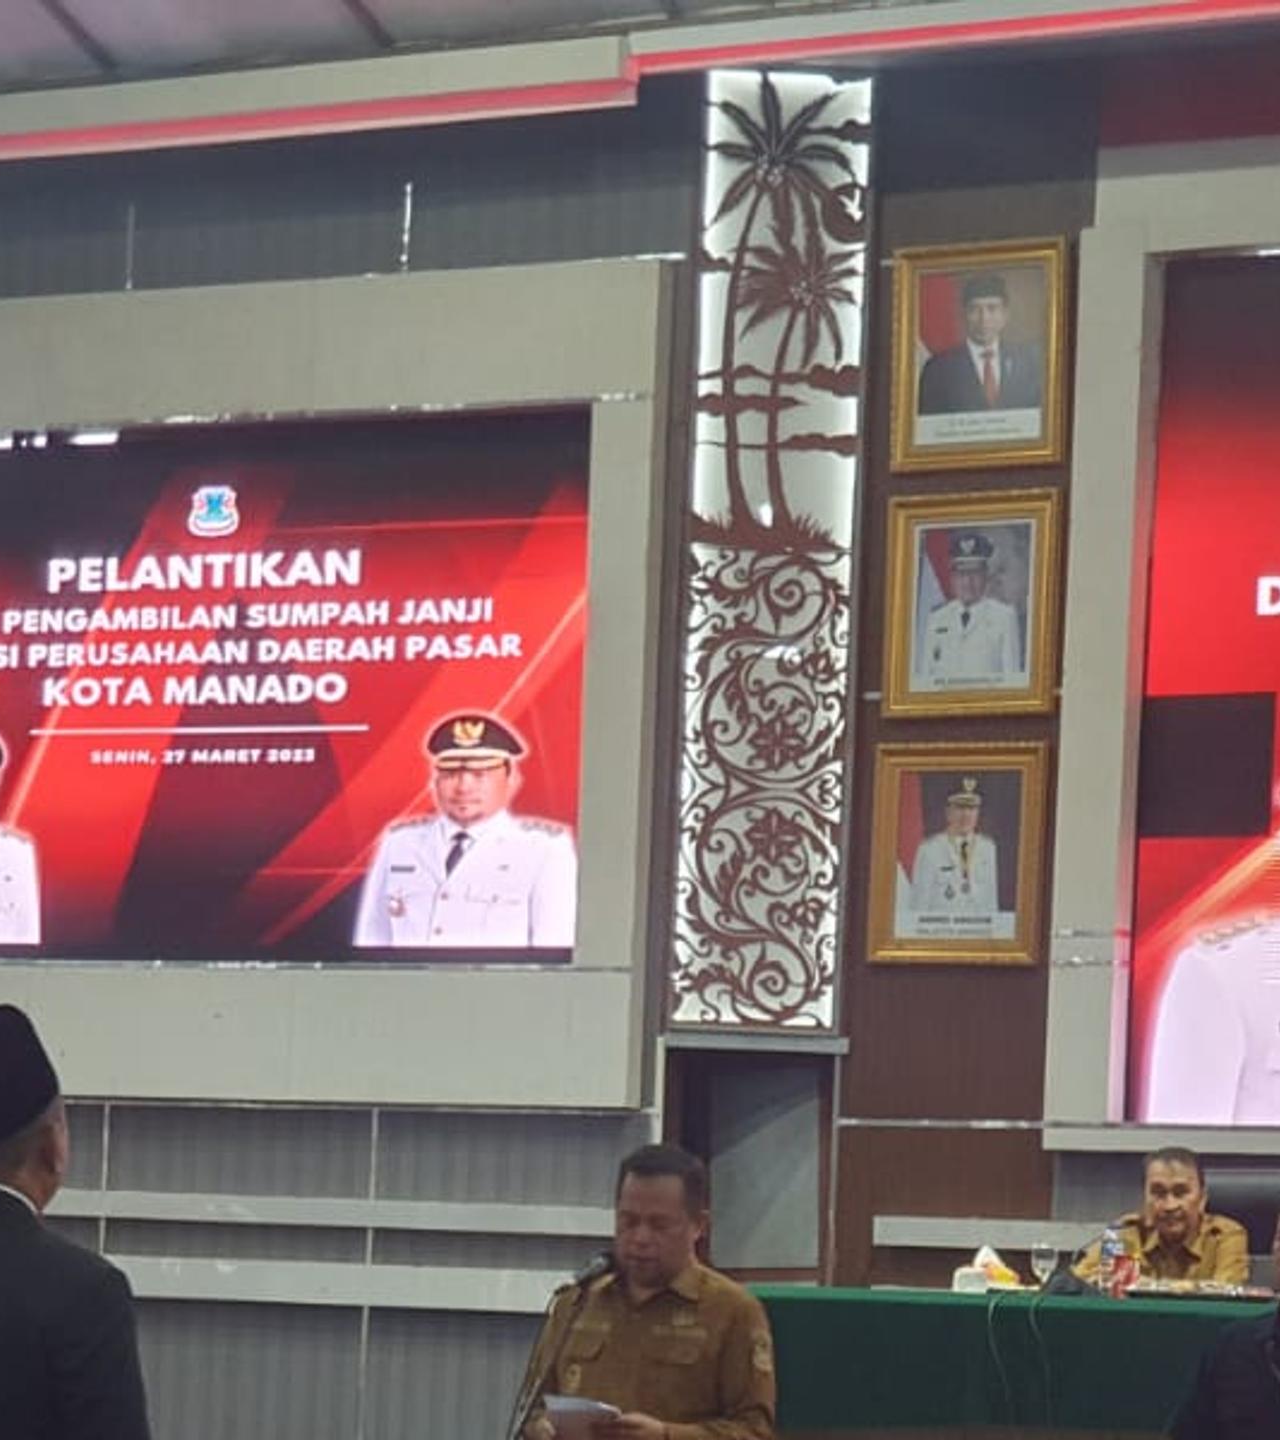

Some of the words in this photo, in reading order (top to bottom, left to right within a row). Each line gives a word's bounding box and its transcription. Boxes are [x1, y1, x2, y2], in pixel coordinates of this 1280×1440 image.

[47, 549, 361, 594] PELANTIKAN
[2, 604, 237, 634] PENGAMBILAN
[245, 600, 388, 628] SUMPAH
[397, 597, 493, 625] JANJI
[27, 639, 249, 668] PERUSAHAAN
[257, 636, 396, 663] DAERAH
[405, 633, 522, 660] PASAR
[42, 677, 152, 707] KOTA
[163, 672, 347, 705] MANADO
[162, 749, 186, 764] 27
[191, 748, 262, 763] MARET
